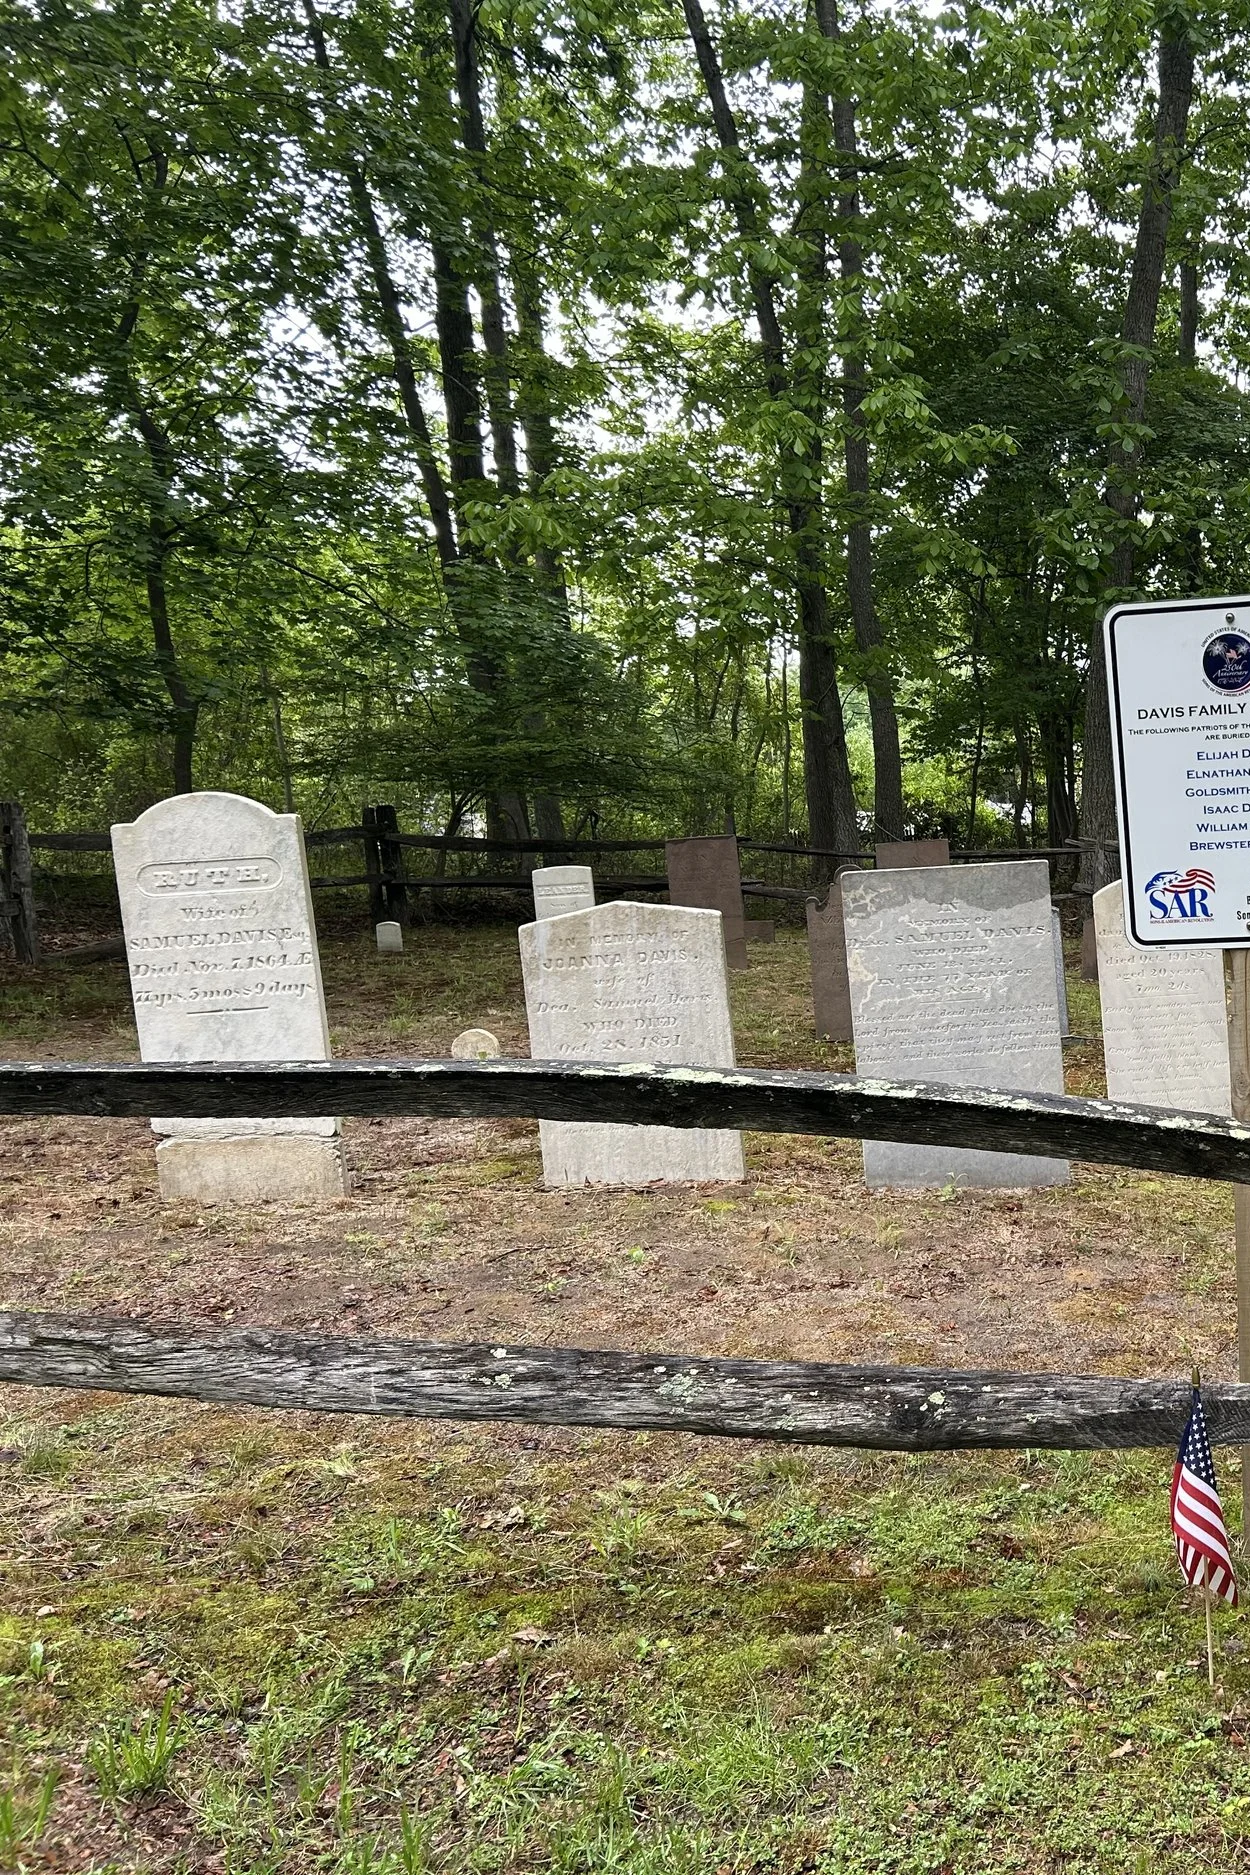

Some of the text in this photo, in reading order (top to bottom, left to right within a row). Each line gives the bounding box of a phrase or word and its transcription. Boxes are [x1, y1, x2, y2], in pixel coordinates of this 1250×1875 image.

[1137, 706, 1185, 720] DAVIS
[1188, 702, 1247, 717] FAMILY
[1145, 726, 1190, 735] FOLLOWING
[1191, 724, 1228, 732] PATRIOTS
[1222, 732, 1250, 740] BURIED
[1196, 750, 1239, 761] ELIJAH
[1186, 768, 1250, 779] ELNATHAN
[1203, 805, 1239, 814] ISAAC
[1196, 822, 1248, 832] WILLIAM
[936, 902, 960, 914] IN
[1149, 888, 1213, 919] SAR
[180, 904, 247, 922] Wife of
[906, 915, 992, 928] MEMORY OF
[129, 932, 215, 951] SAMUEL
[216, 928, 277, 945] DAVIS
[558, 930, 690, 950] IN MEMORY OF
[895, 930, 976, 946] SAMUEL
[911, 944, 989, 958] WHO DIED
[542, 952, 624, 971] JOANNA
[896, 961, 937, 972] JUNE
[1105, 955, 1136, 967] died
[131, 961, 180, 979] Died
[1150, 967, 1167, 977] 20
[877, 977, 896, 987] IN
[902, 975, 937, 985] THE
[1016, 967, 1033, 976] OF
[854, 1014, 894, 1025] Blessed
[918, 1010, 937, 1020] the
[939, 1007, 966, 1018] dead
[582, 1016, 678, 1034] WHO DIED
[854, 1027, 880, 1039] Lord
